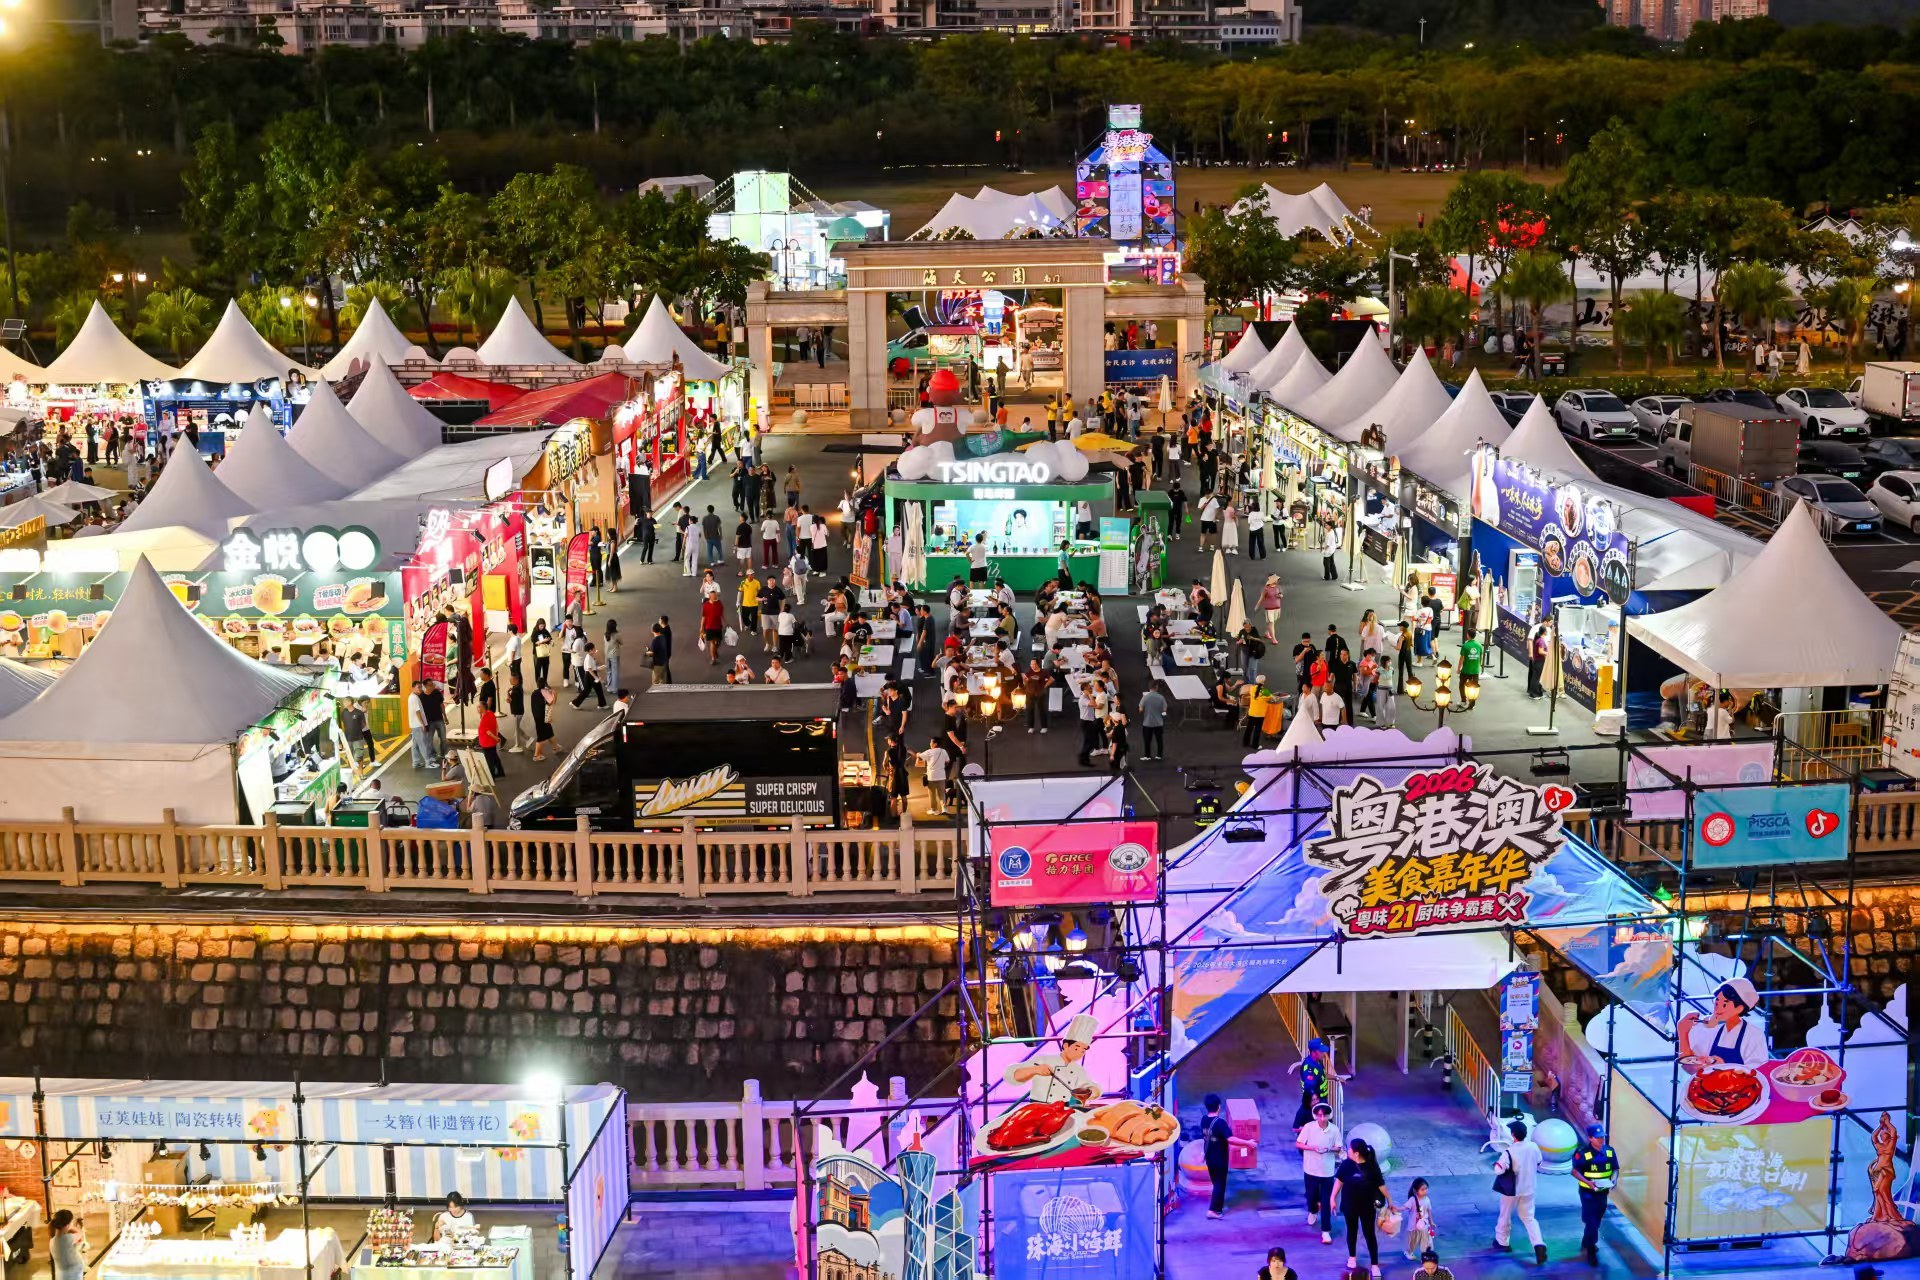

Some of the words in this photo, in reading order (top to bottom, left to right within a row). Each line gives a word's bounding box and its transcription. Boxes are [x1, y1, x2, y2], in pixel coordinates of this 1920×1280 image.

[937, 461, 1050, 483] TSINGTAO
[222, 532, 302, 571] 金悦
[756, 783, 784, 796] SUPER
[786, 782, 817, 795] CRISPY
[1405, 764, 1477, 802] 2026
[750, 801, 778, 814] SUPER
[780, 800, 825, 814] DELICIOUS
[1322, 781, 1550, 878] 粤港澳
[1045, 864, 1095, 876] 格力集团
[1060, 853, 1093, 863] GREE
[1361, 847, 1530, 907] 美食嘉年华
[1355, 899, 1497, 931] 粤味21厨味争霸赛
[1026, 1228, 1123, 1261] 珠海小海鲜
